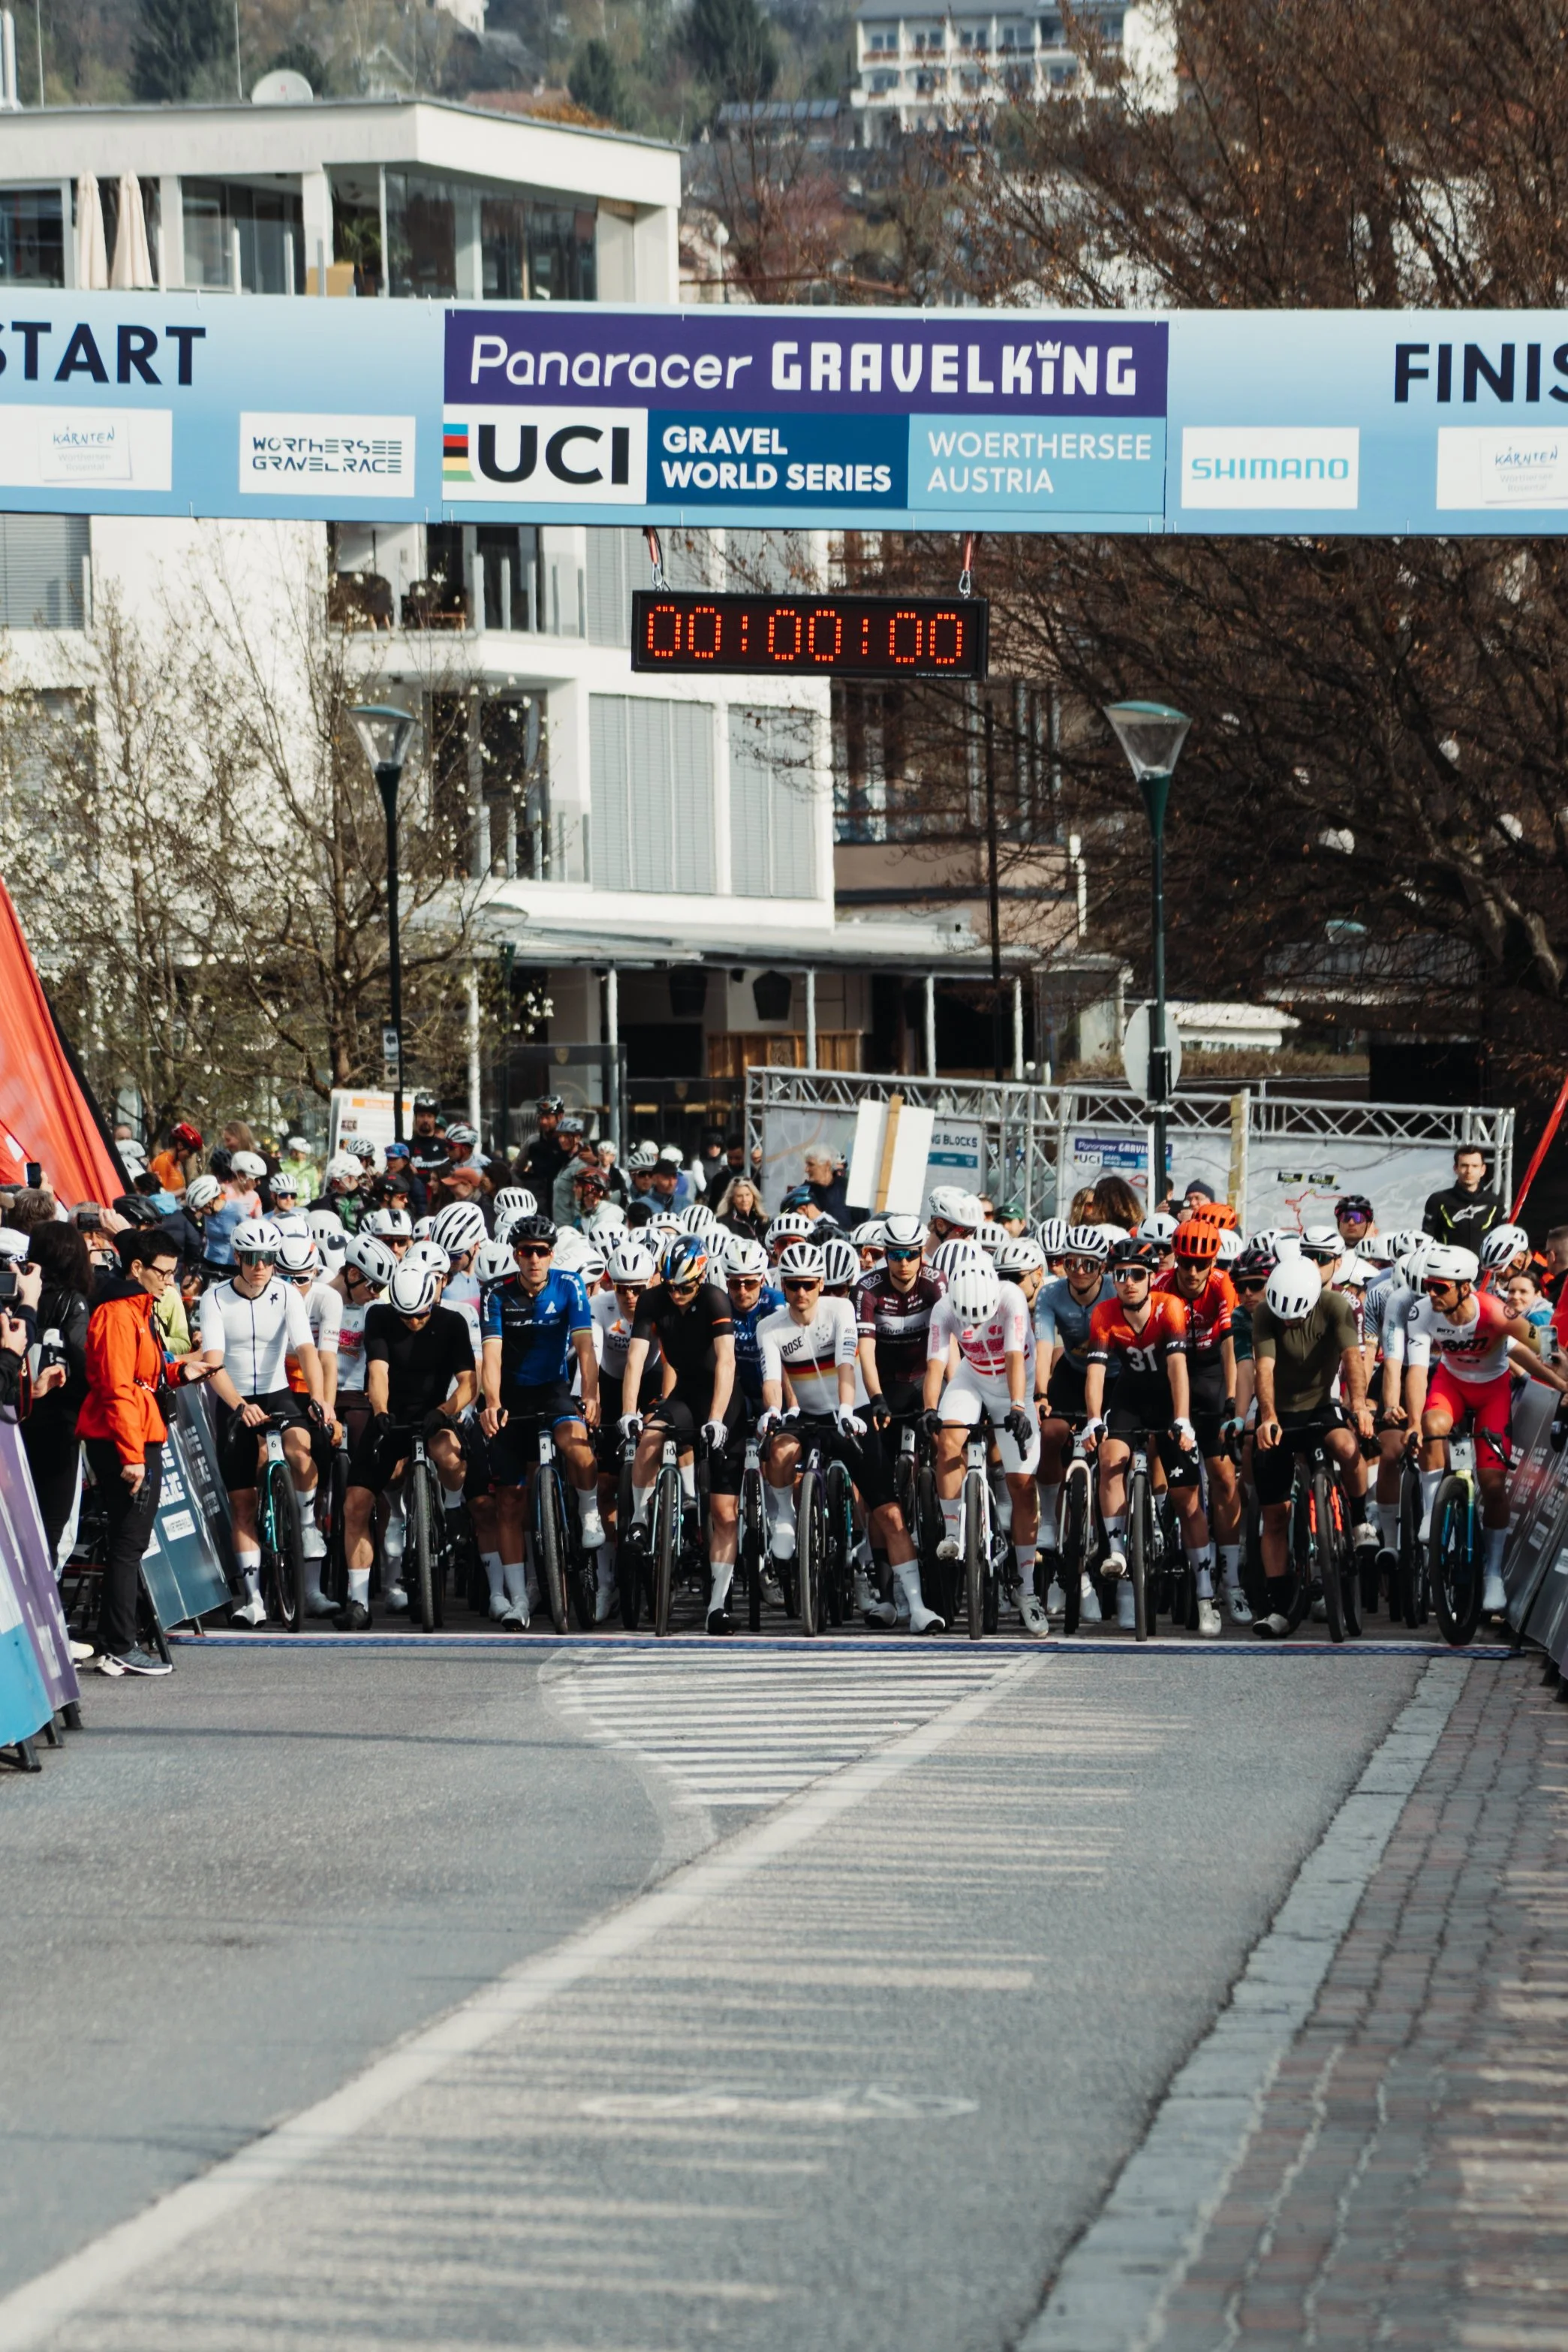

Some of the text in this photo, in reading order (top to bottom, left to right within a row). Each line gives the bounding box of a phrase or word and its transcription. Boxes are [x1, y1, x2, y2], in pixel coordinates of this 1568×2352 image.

[0, 321, 206, 386] TART
[470, 335, 1136, 396] Panaracer GRAVELKING
[662, 425, 787, 455] GRAVEL
[927, 430, 1151, 460] WOERTHERSEE
[477, 423, 629, 486] UCI
[1191, 457, 1350, 480] SHIMANO
[661, 461, 891, 493] WORLD SERIES
[927, 467, 1055, 494] AUSTRIA
[649, 605, 963, 664] 00:00:00
[943, 1133, 978, 1149] BLOCKS
[1079, 1154, 1100, 1164] UCI
[781, 1336, 804, 1357] ROSE
[1127, 1344, 1158, 1372] 3T
[973, 1450, 977, 1458] 1
[1455, 1447, 1465, 1456] 24
